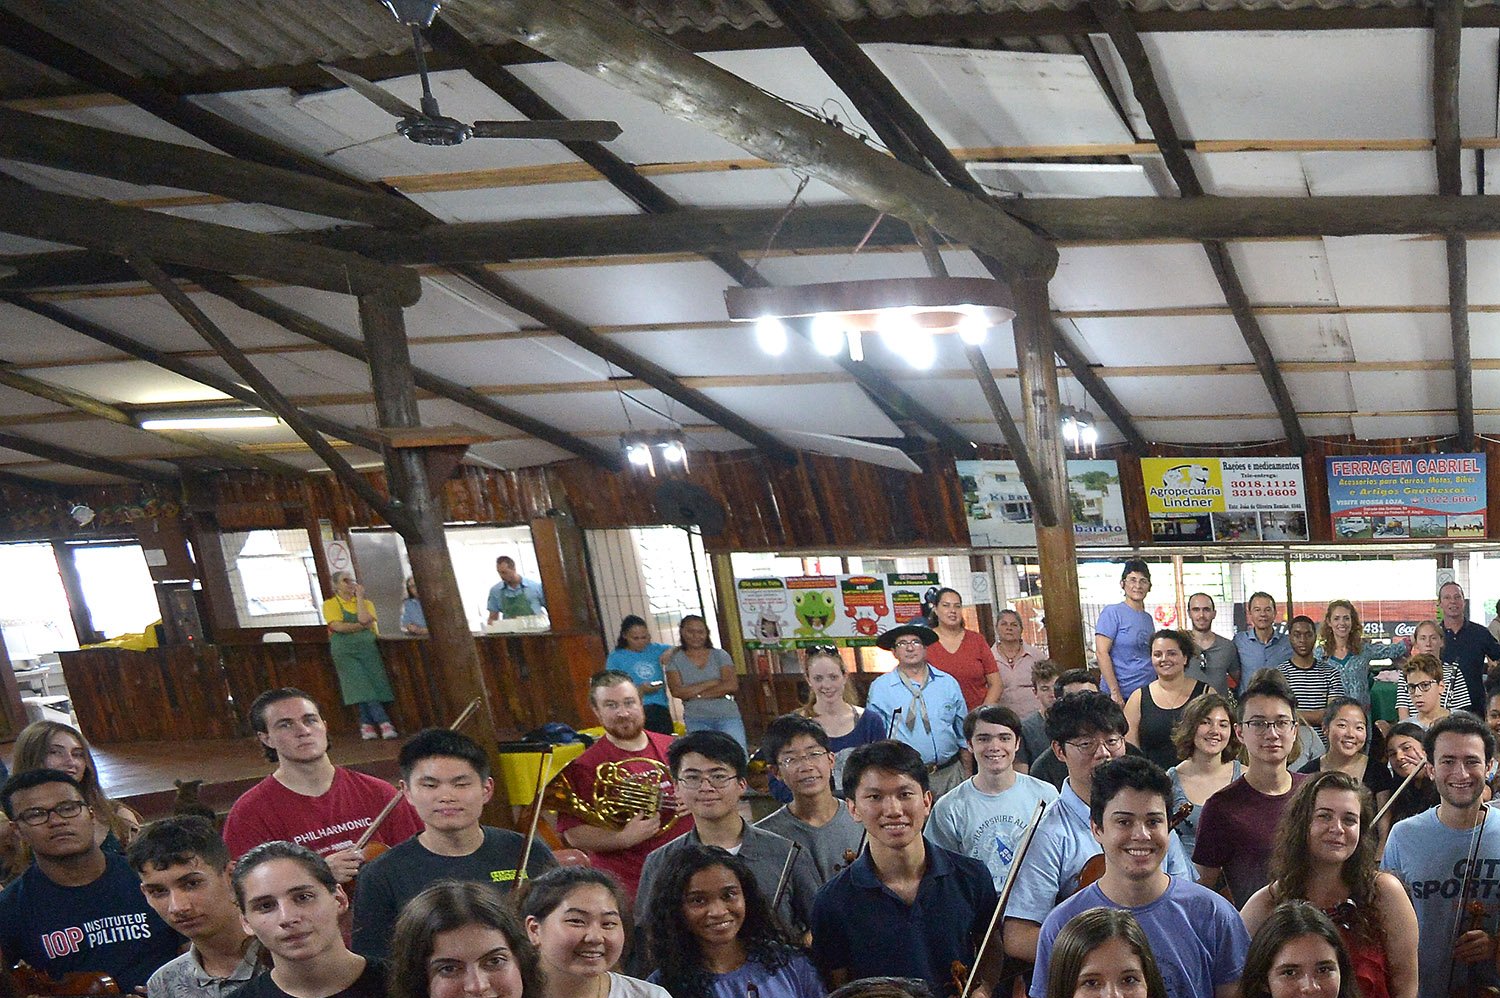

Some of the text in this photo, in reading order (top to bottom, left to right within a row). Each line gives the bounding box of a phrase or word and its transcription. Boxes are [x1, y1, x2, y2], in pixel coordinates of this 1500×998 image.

[1332, 458, 1481, 476] FERRAGEM GABRIEL
[1231, 480, 1296, 488] 3018.1112
[1150, 487, 1221, 498] Agropecuária
[1232, 489, 1297, 497] 3319.6609
[1360, 488, 1399, 496] Artigos
[1164, 498, 1213, 507] Lindner
[293, 817, 373, 845] PHILHARMONIC
[83, 912, 148, 933] INSTITUTE OF
[41, 926, 85, 959] IOP
[88, 923, 152, 949] POLITICS
